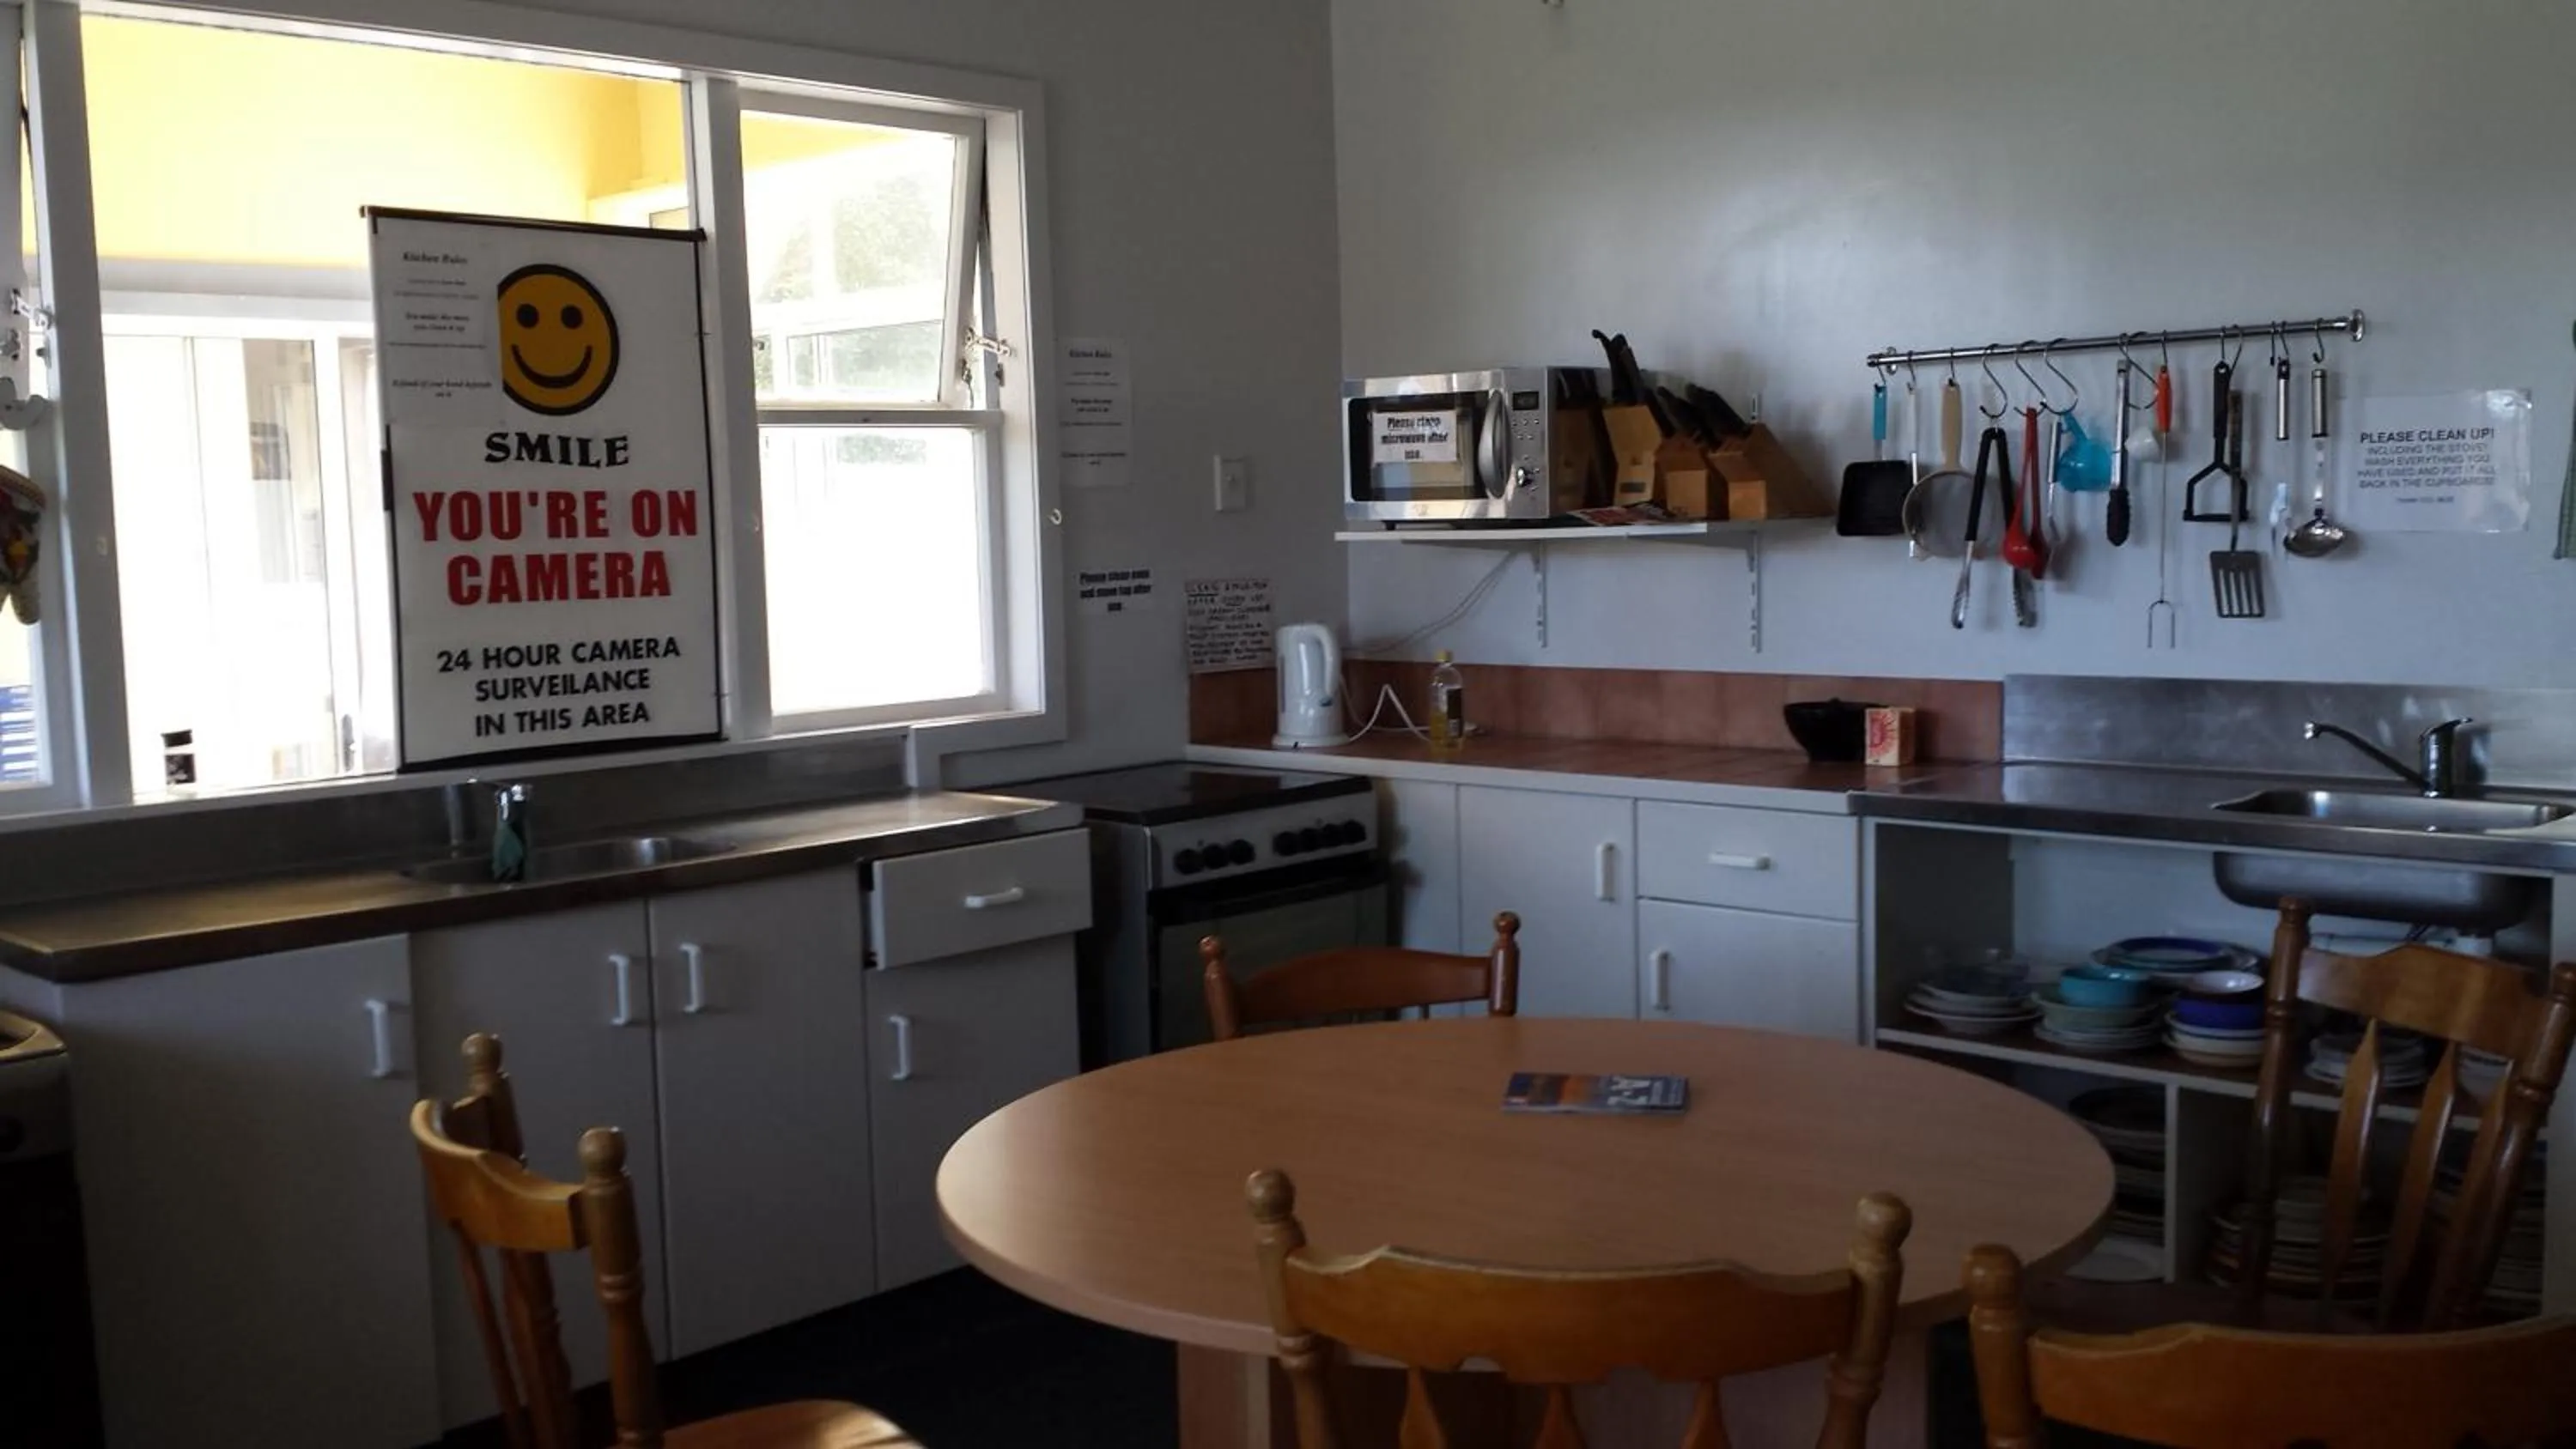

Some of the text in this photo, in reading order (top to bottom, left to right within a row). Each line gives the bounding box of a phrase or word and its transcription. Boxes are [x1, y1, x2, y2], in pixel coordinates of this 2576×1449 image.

[484, 432, 629, 468] SMILE
[2360, 427, 2494, 444] PLEASE CLEAN UP!
[2367, 445, 2422, 455] INCLUDING
[2425, 444, 2445, 453] THE
[2397, 455, 2464, 465] EVERYTHING
[412, 488, 697, 542] YOU'RE ON
[447, 550, 671, 607] CAMERA
[437, 636, 680, 672] 24 HOUR CAMERA
[476, 668, 651, 702] SURVEILANCE
[476, 702, 650, 737] IN THIS AREA
